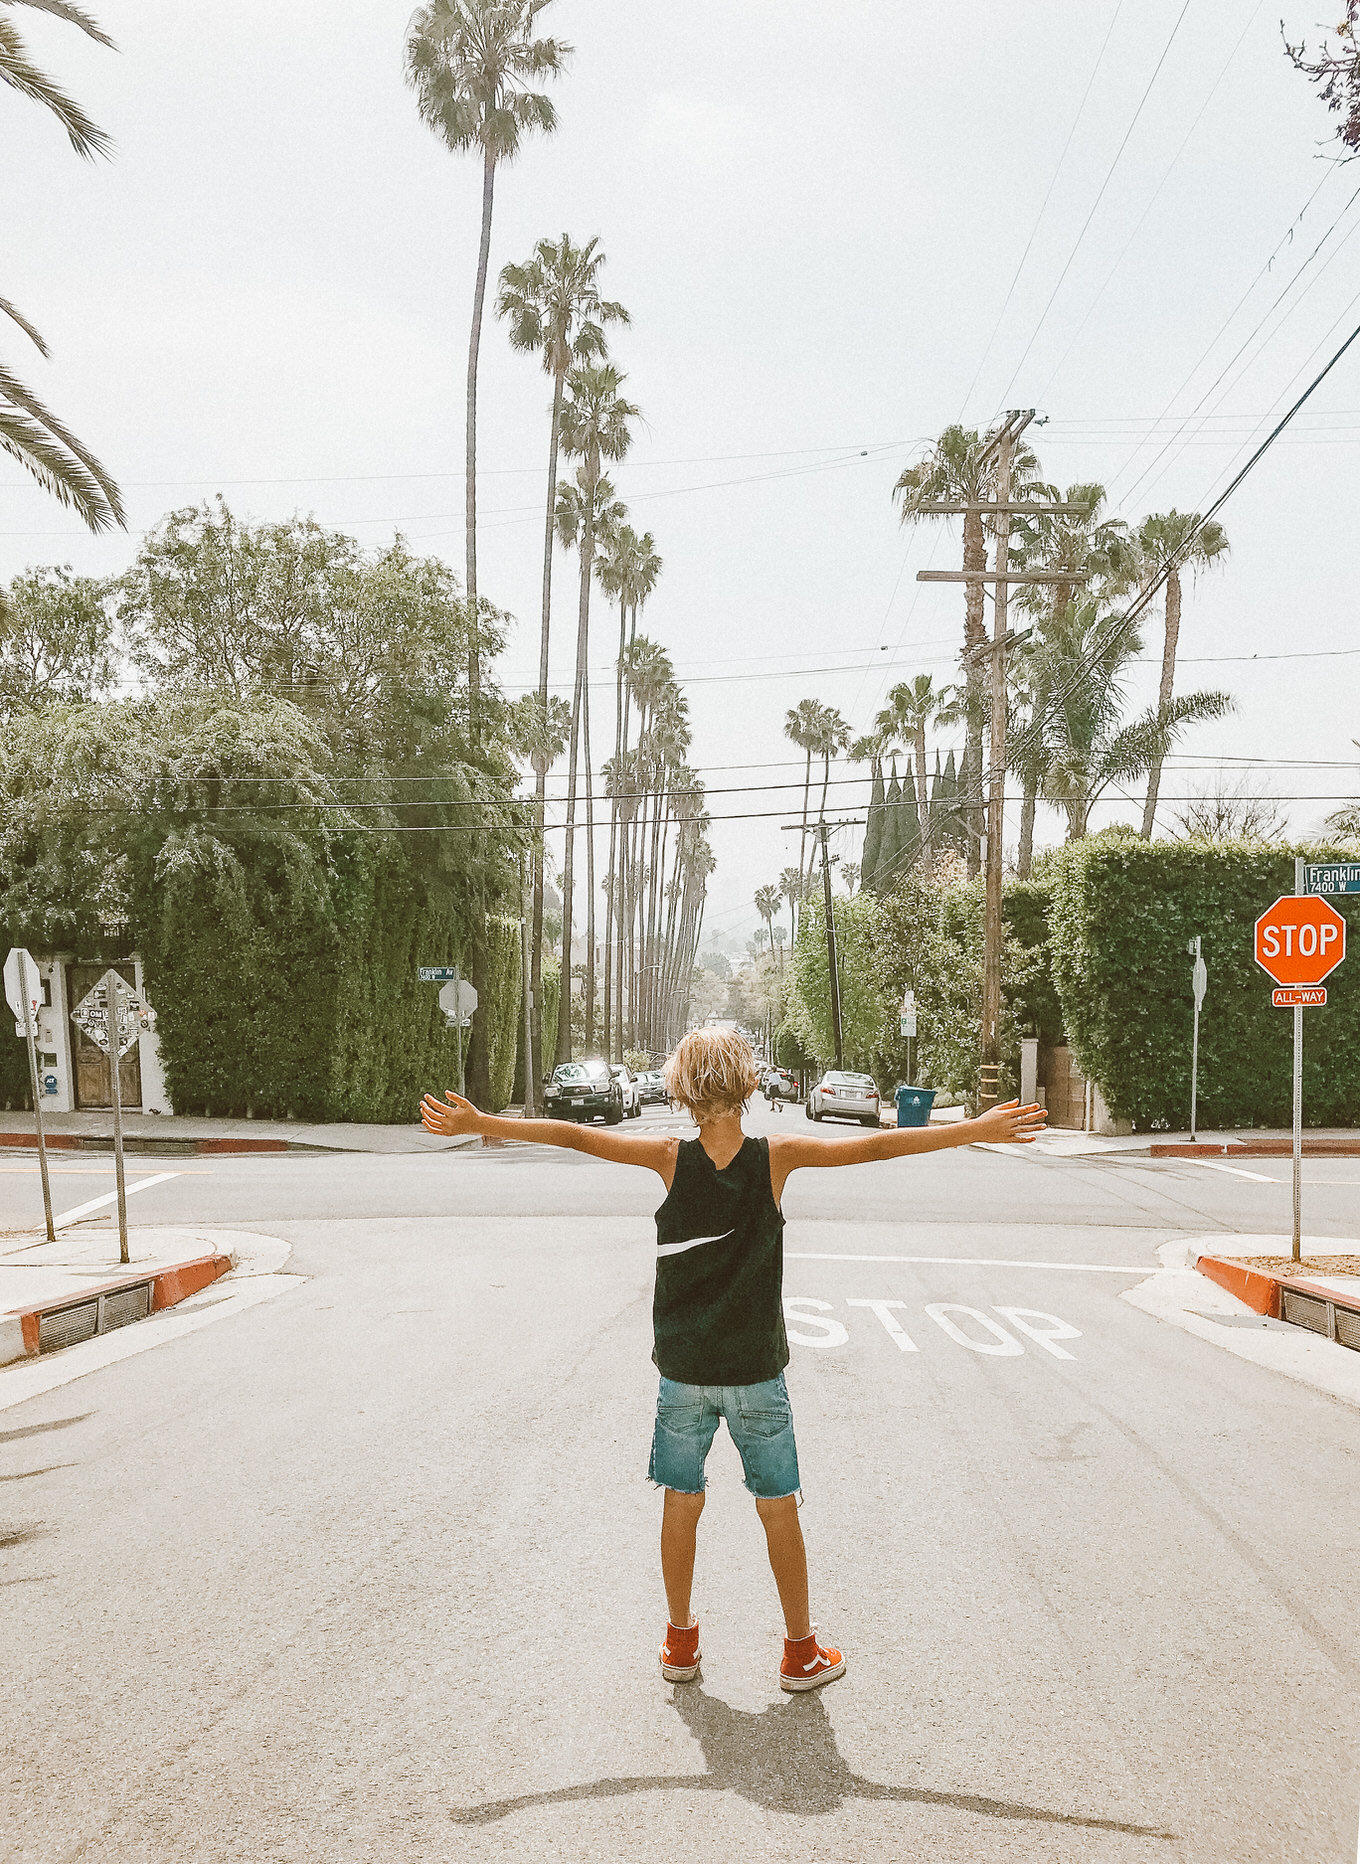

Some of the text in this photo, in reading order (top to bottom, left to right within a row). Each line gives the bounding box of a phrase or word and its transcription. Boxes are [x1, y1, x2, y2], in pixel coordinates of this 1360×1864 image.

[1309, 866, 1360, 882] Franklin
[1309, 881, 1347, 892] 7400 W
[1262, 923, 1338, 957] STOP
[1275, 991, 1324, 1003] ALL-WAY
[782, 1296, 1083, 1361] STOP
